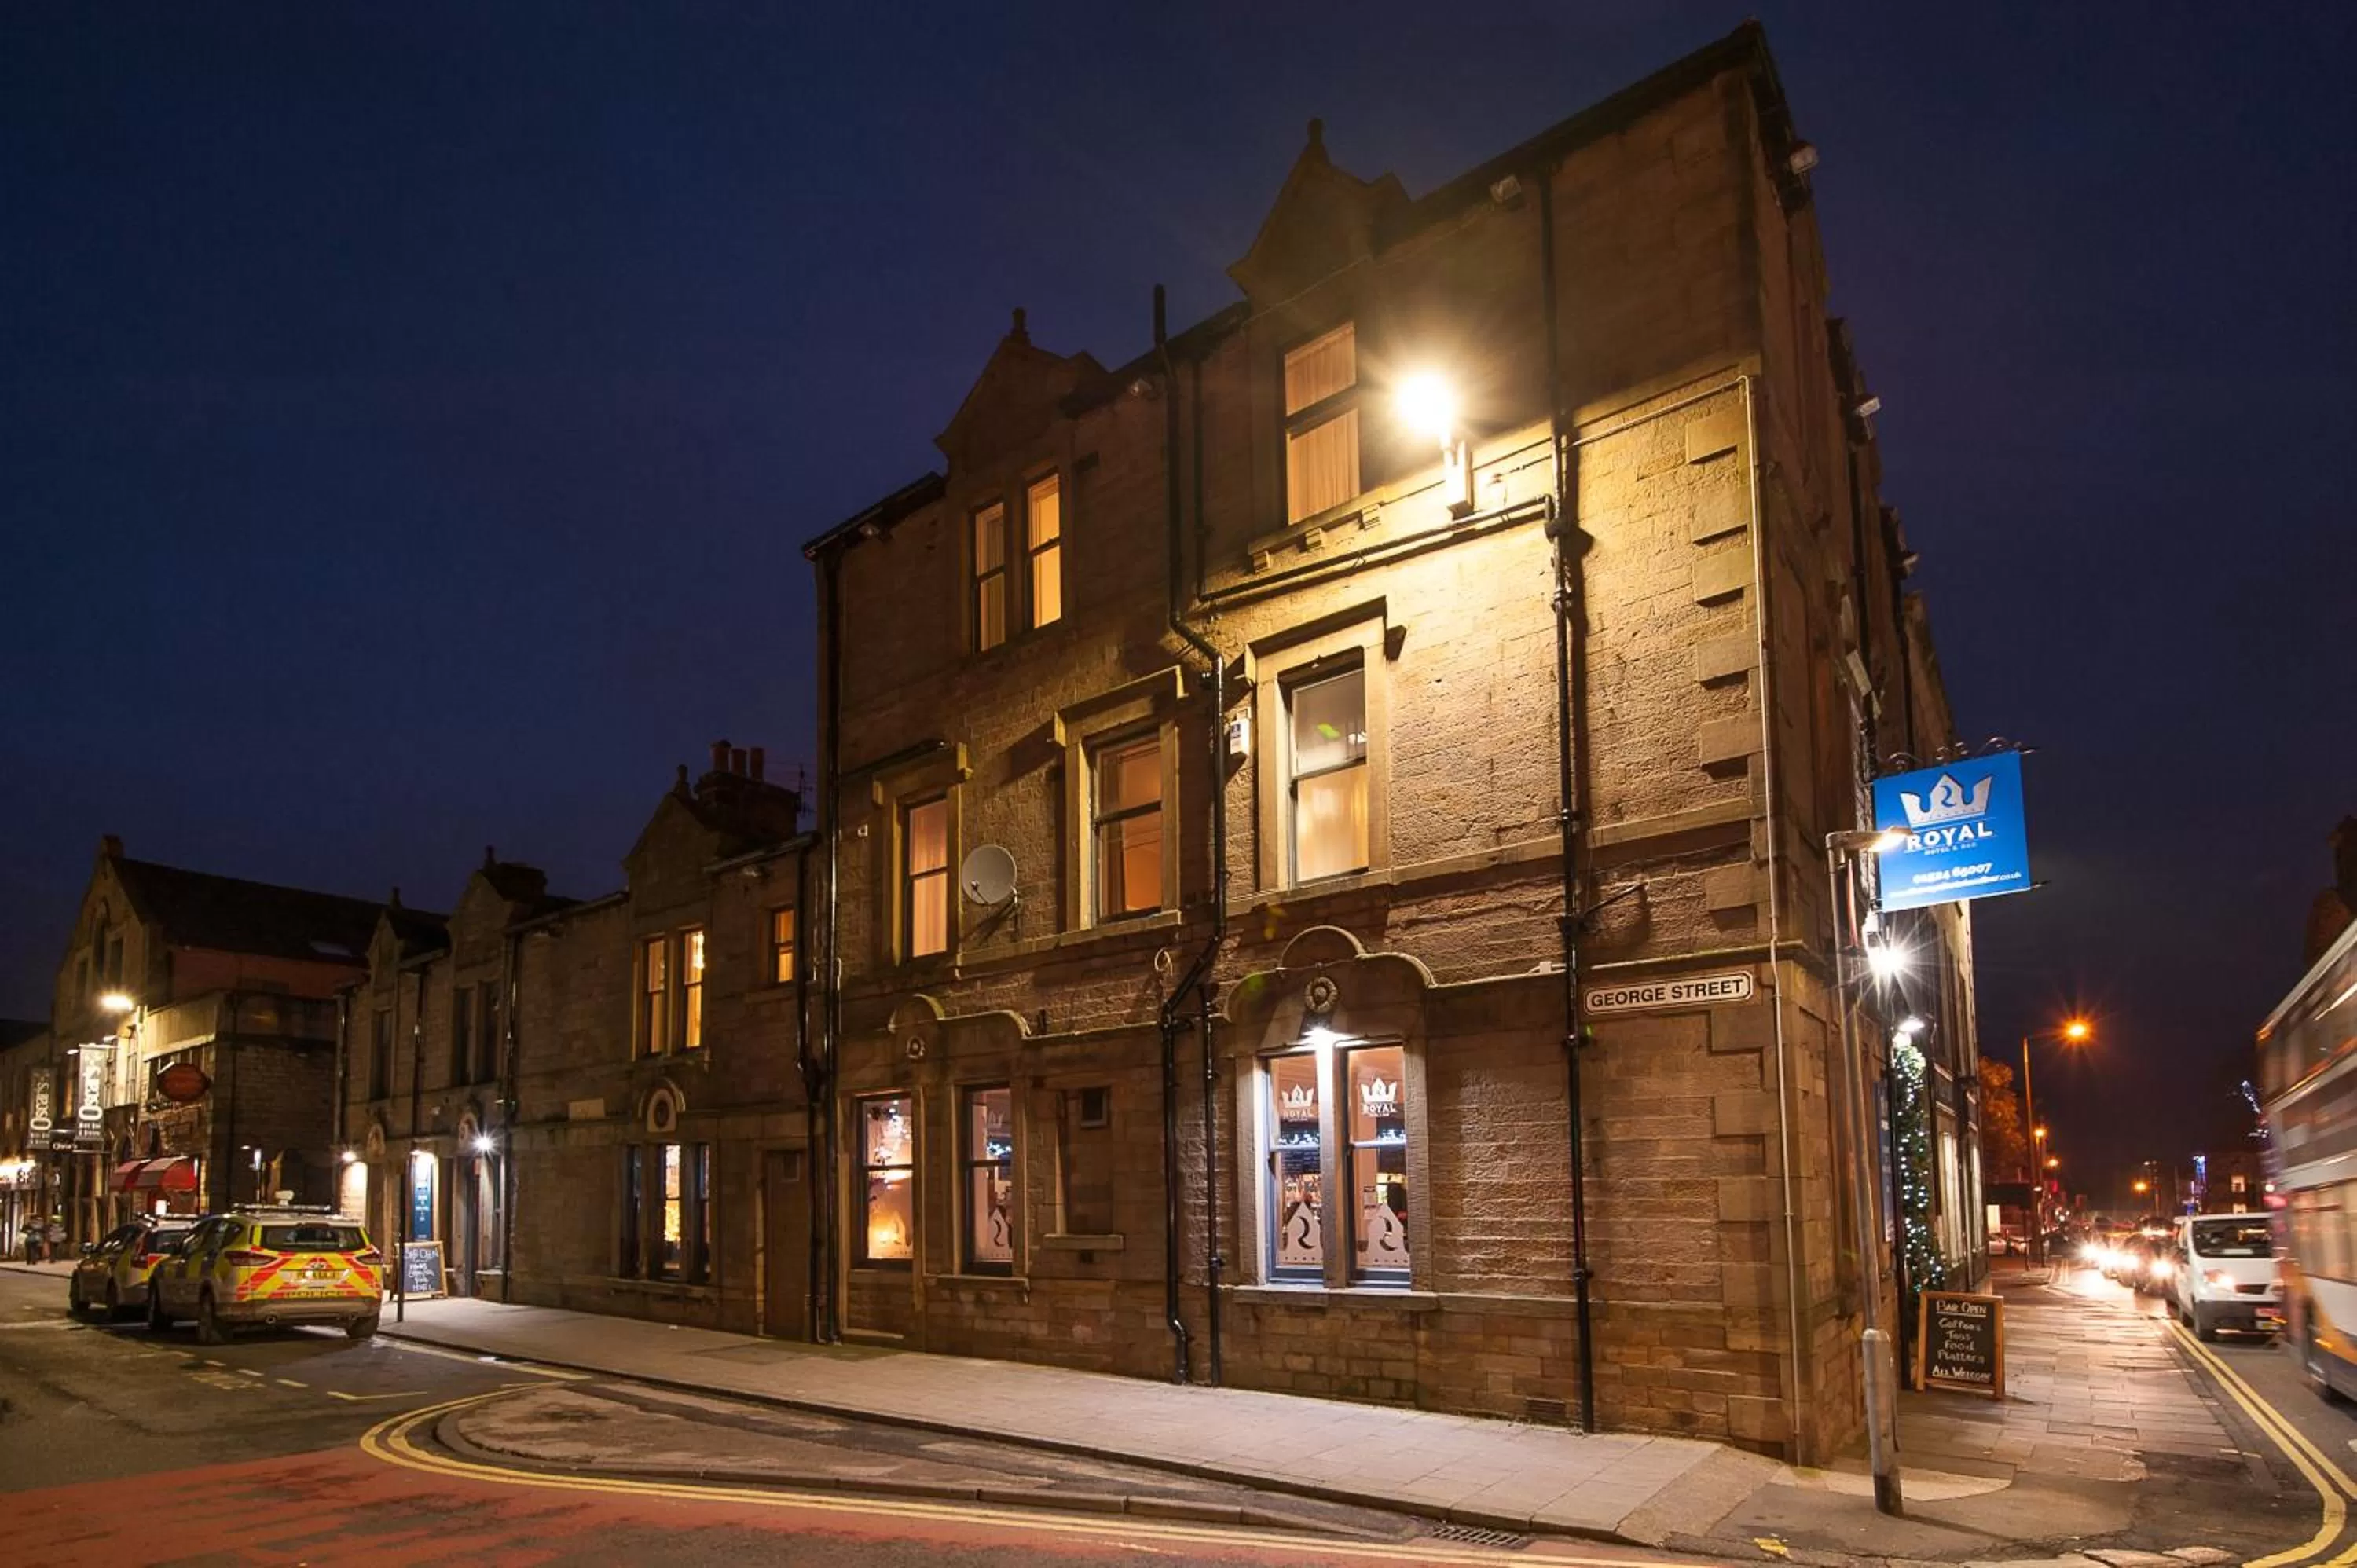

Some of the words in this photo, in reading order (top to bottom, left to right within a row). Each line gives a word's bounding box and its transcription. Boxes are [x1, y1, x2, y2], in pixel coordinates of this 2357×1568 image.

[1907, 822, 1993, 851] ROYAL
[1591, 987, 1666, 1007] GEORGE
[1671, 979, 1743, 998] STREET
[1363, 1103, 1398, 1113] ROYAL
[1961, 1302, 1986, 1314] OPEN
[1945, 1339, 1974, 1350] Food
